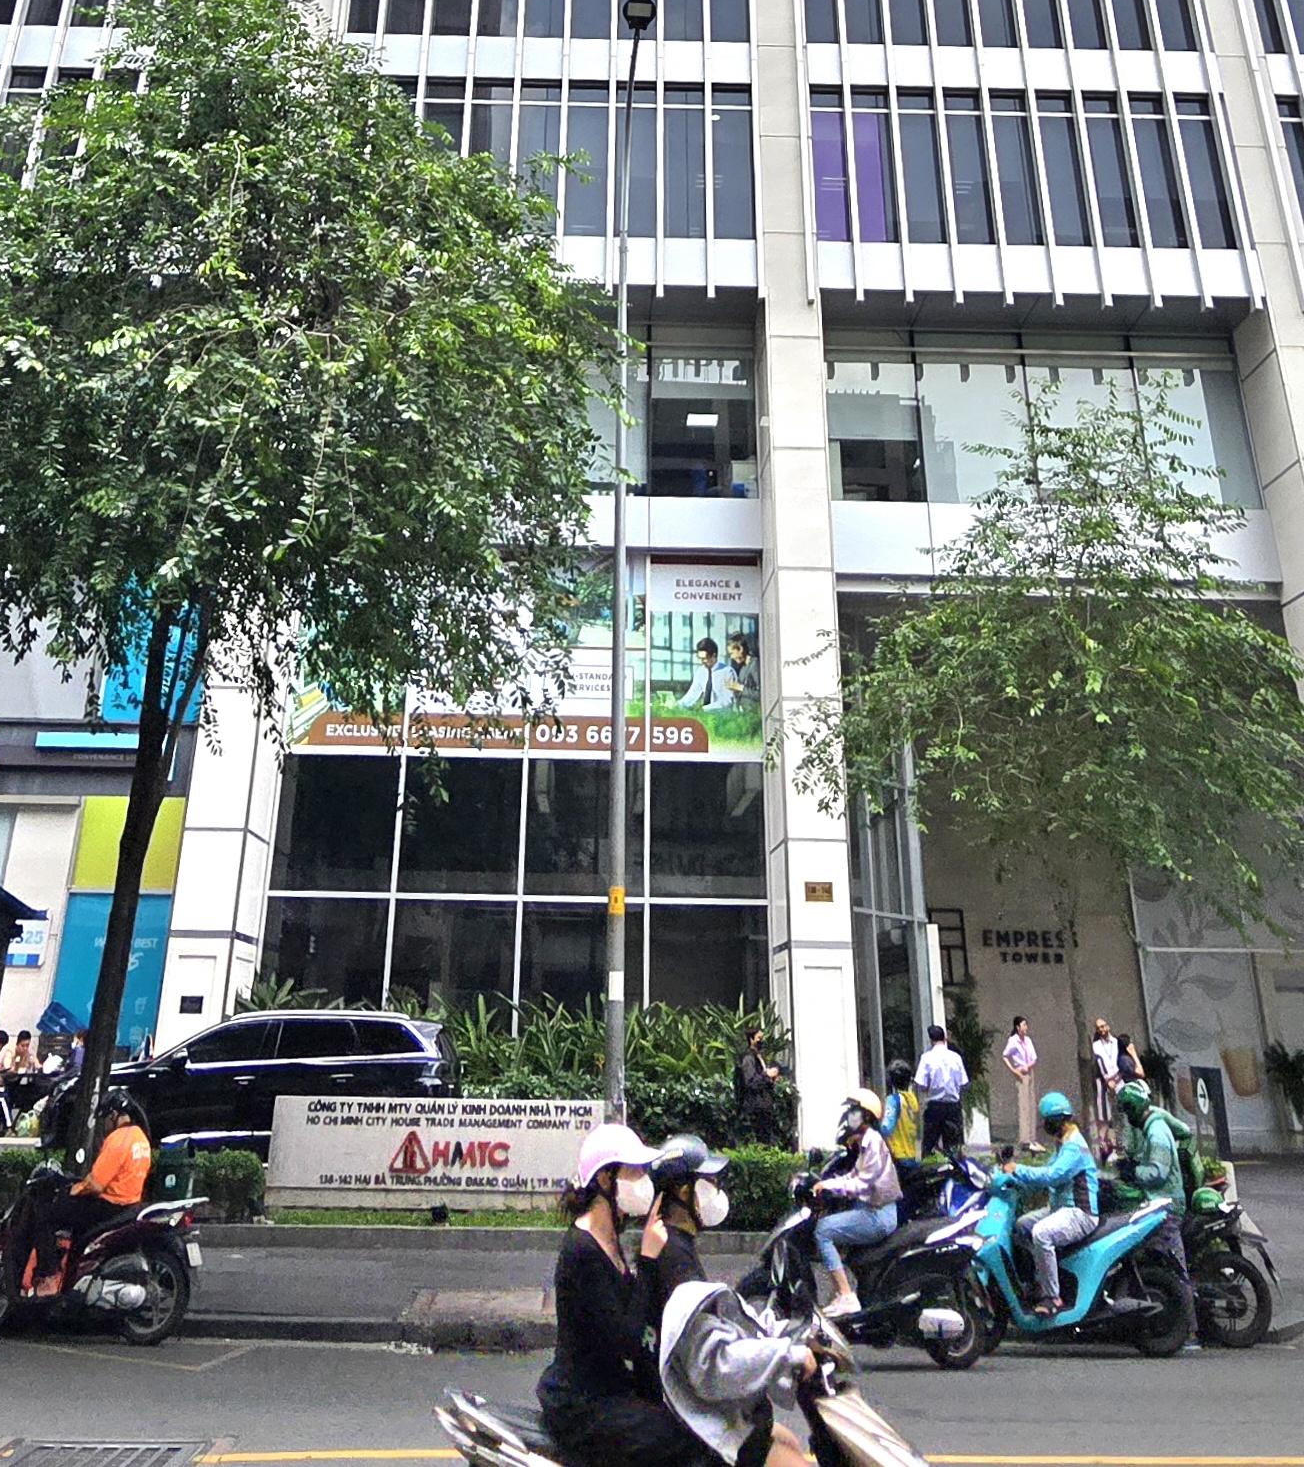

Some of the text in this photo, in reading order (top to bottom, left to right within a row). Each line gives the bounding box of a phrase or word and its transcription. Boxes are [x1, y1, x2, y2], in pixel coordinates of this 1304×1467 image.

[676, 579, 741, 589] ELEGANCE &
[674, 591, 743, 601] CONVENIENT
[574, 683, 611, 692] ERVICES
[535, 724, 579, 743] 093
[585, 725, 641, 744] 667
[652, 726, 694, 745] 596
[134, 937, 159, 948] BEST
[1000, 951, 1064, 964] TOWER
[307, 1099, 337, 1112] CÔNG
[340, 1102, 353, 1113] TY
[357, 1102, 385, 1113] TNHH
[388, 1102, 412, 1114] MTV
[462, 1104, 486, 1115] KINH
[489, 1104, 527, 1116] DOANH
[529, 1103, 551, 1116] NHÀ
[554, 1105, 567, 1116] TP
[569, 1105, 593, 1117] HCM
[323, 1115, 338, 1126] CHI
[340, 1115, 363, 1126] MINH
[366, 1116, 387, 1126] CITY
[391, 1117, 421, 1127] HOUSE
[425, 1117, 454, 1128] TRADE
[459, 1118, 523, 1129] MANAGEMENT
[526, 1119, 571, 1130] COMPANY
[575, 1120, 591, 1131] LTD
[432, 1140, 511, 1169] HMTC
[354, 1174, 372, 1186] HAI
[374, 1172, 386, 1186] BÀ
